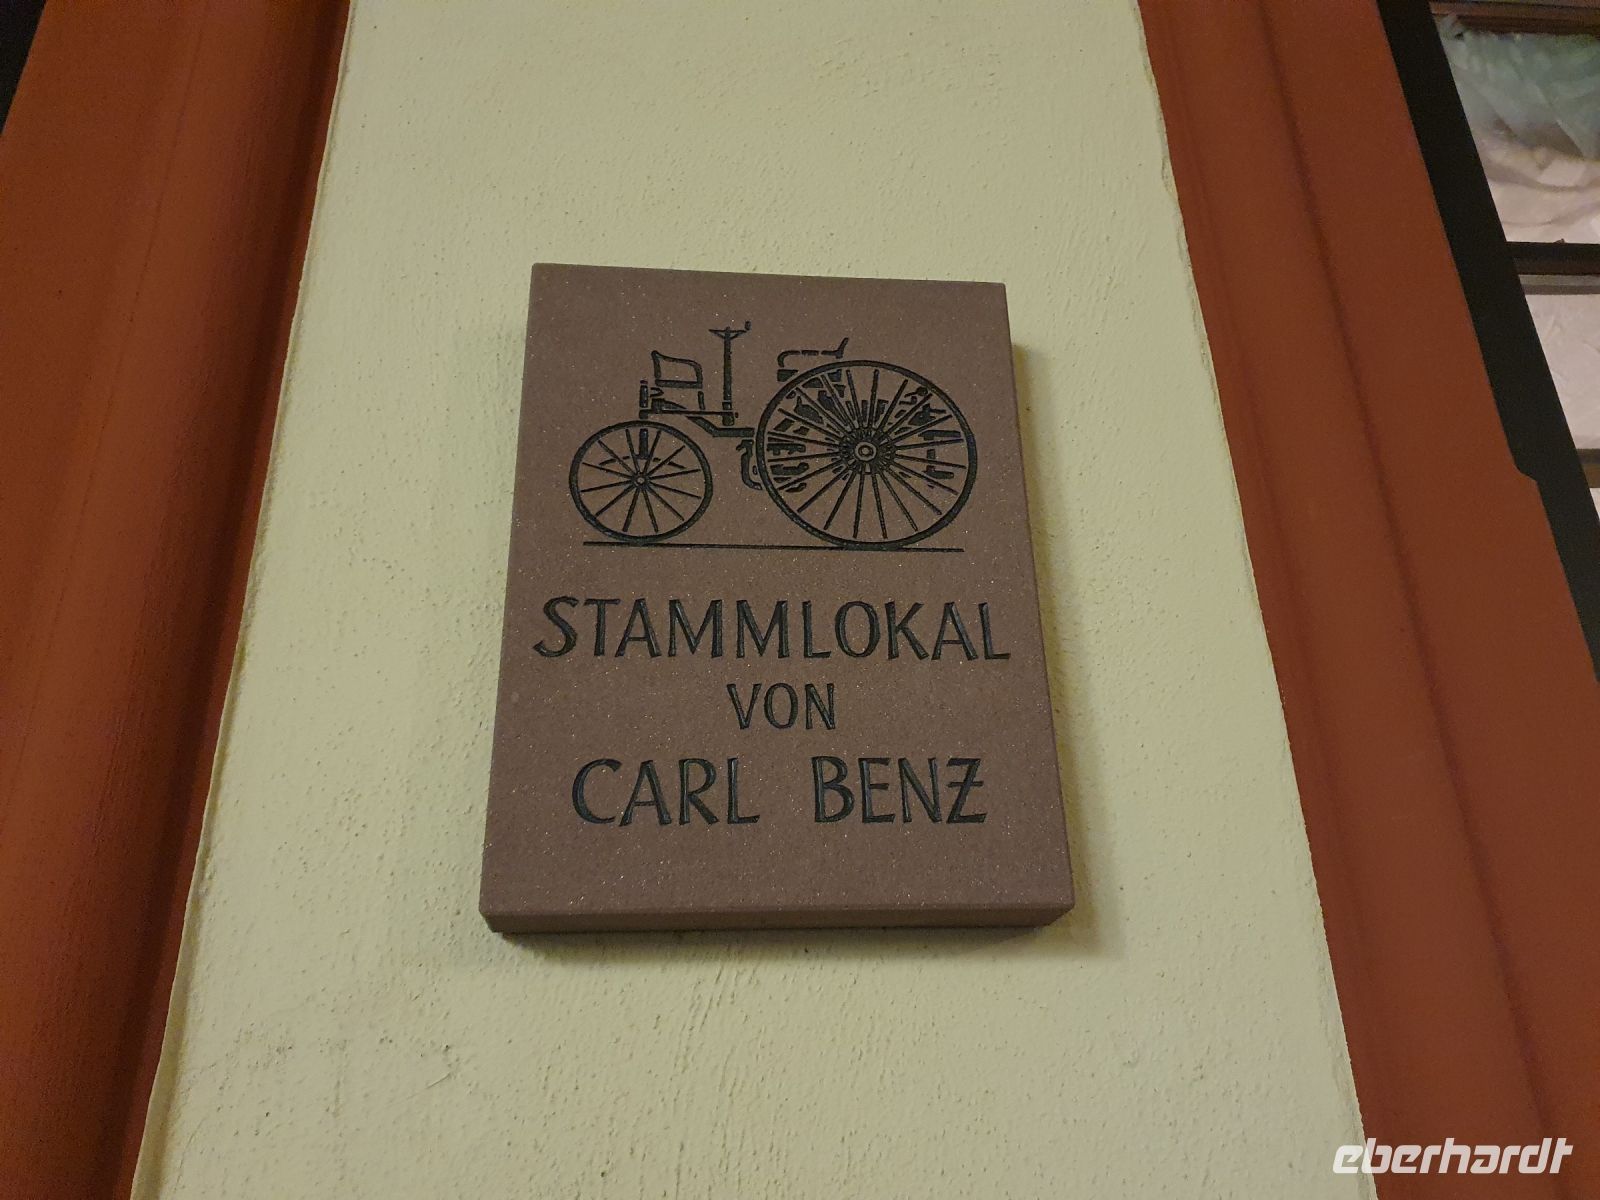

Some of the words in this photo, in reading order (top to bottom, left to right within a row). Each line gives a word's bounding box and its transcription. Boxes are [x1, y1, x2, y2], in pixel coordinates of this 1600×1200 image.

[533, 595, 1011, 661] STAMMLOKAL
[726, 683, 836, 730] VON
[571, 757, 760, 827] CARL
[811, 755, 987, 825] BENZ
